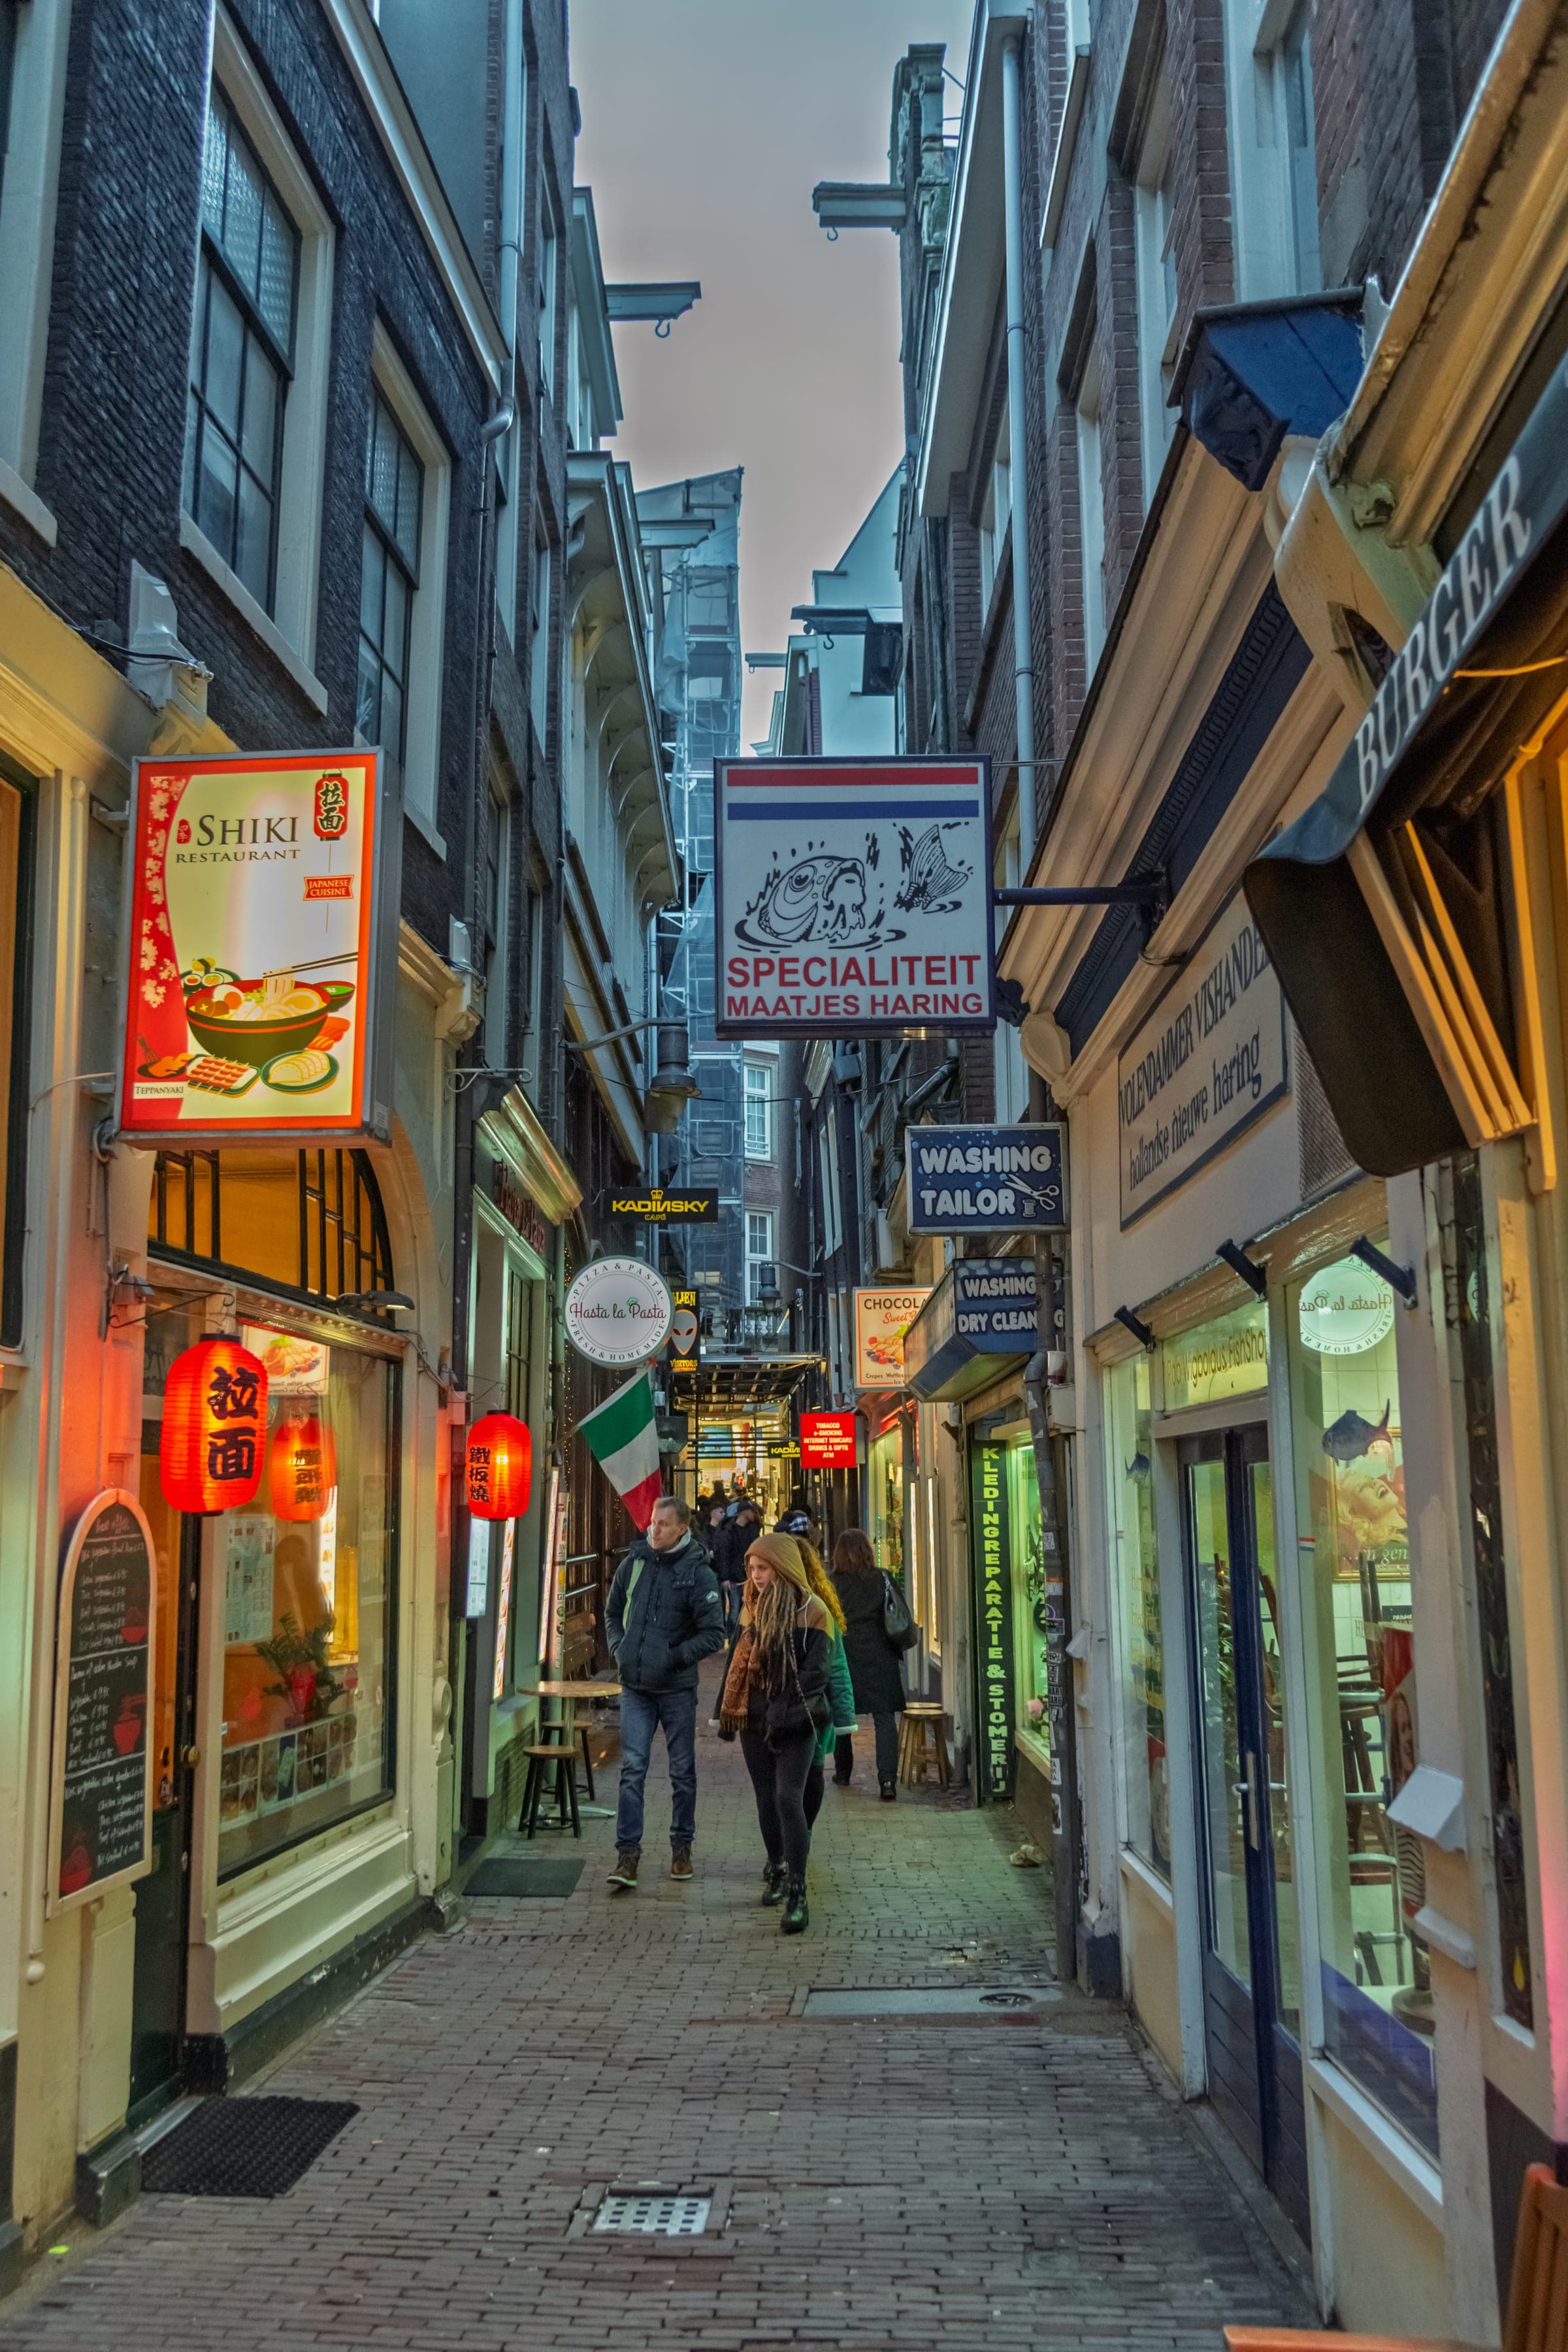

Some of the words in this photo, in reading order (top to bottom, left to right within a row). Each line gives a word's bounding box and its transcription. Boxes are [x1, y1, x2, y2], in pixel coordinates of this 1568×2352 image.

[1356, 455, 1531, 814] BURGER
[318, 781, 344, 830] 拉面
[197, 815, 299, 847] SHIKI
[176, 849, 301, 863] RESTAURANT
[309, 879, 349, 889] JAPANESE
[727, 955, 981, 988] SPECIALITEIT
[727, 994, 860, 1017] MAATJES
[870, 992, 983, 1015] HARING
[1119, 1004, 1194, 1129] VOLENDAMMER
[1130, 1119, 1169, 1192] hollandse
[1172, 1086, 1208, 1153] nieuwe
[1213, 1025, 1262, 1116] haring
[920, 1145, 1052, 1173] WASHING
[920, 1188, 1015, 1216] TAILOR
[574, 1265, 608, 1296] PIZZA
[629, 1264, 663, 1297] PASTA
[964, 1276, 1036, 1298] WASHING
[570, 1302, 610, 1318] Hasta
[613, 1303, 626, 1318] la
[629, 1303, 666, 1318] Pasta
[674, 1292, 696, 1306] LIEN
[883, 1312, 908, 1324] Sweet
[958, 1313, 988, 1333] DRY
[992, 1309, 1064, 1331] CLEANG
[571, 1322, 596, 1354] FRESH
[610, 1350, 642, 1360] HOME
[644, 1324, 665, 1350] MADE
[1228, 1327, 1267, 1369] FishSho
[208, 1366, 260, 1480] 拉面
[983, 1448, 1004, 1659] KLEDINGREPARATIE
[987, 1664, 1007, 1678] &
[988, 1684, 1007, 1792] STOMERIJ
